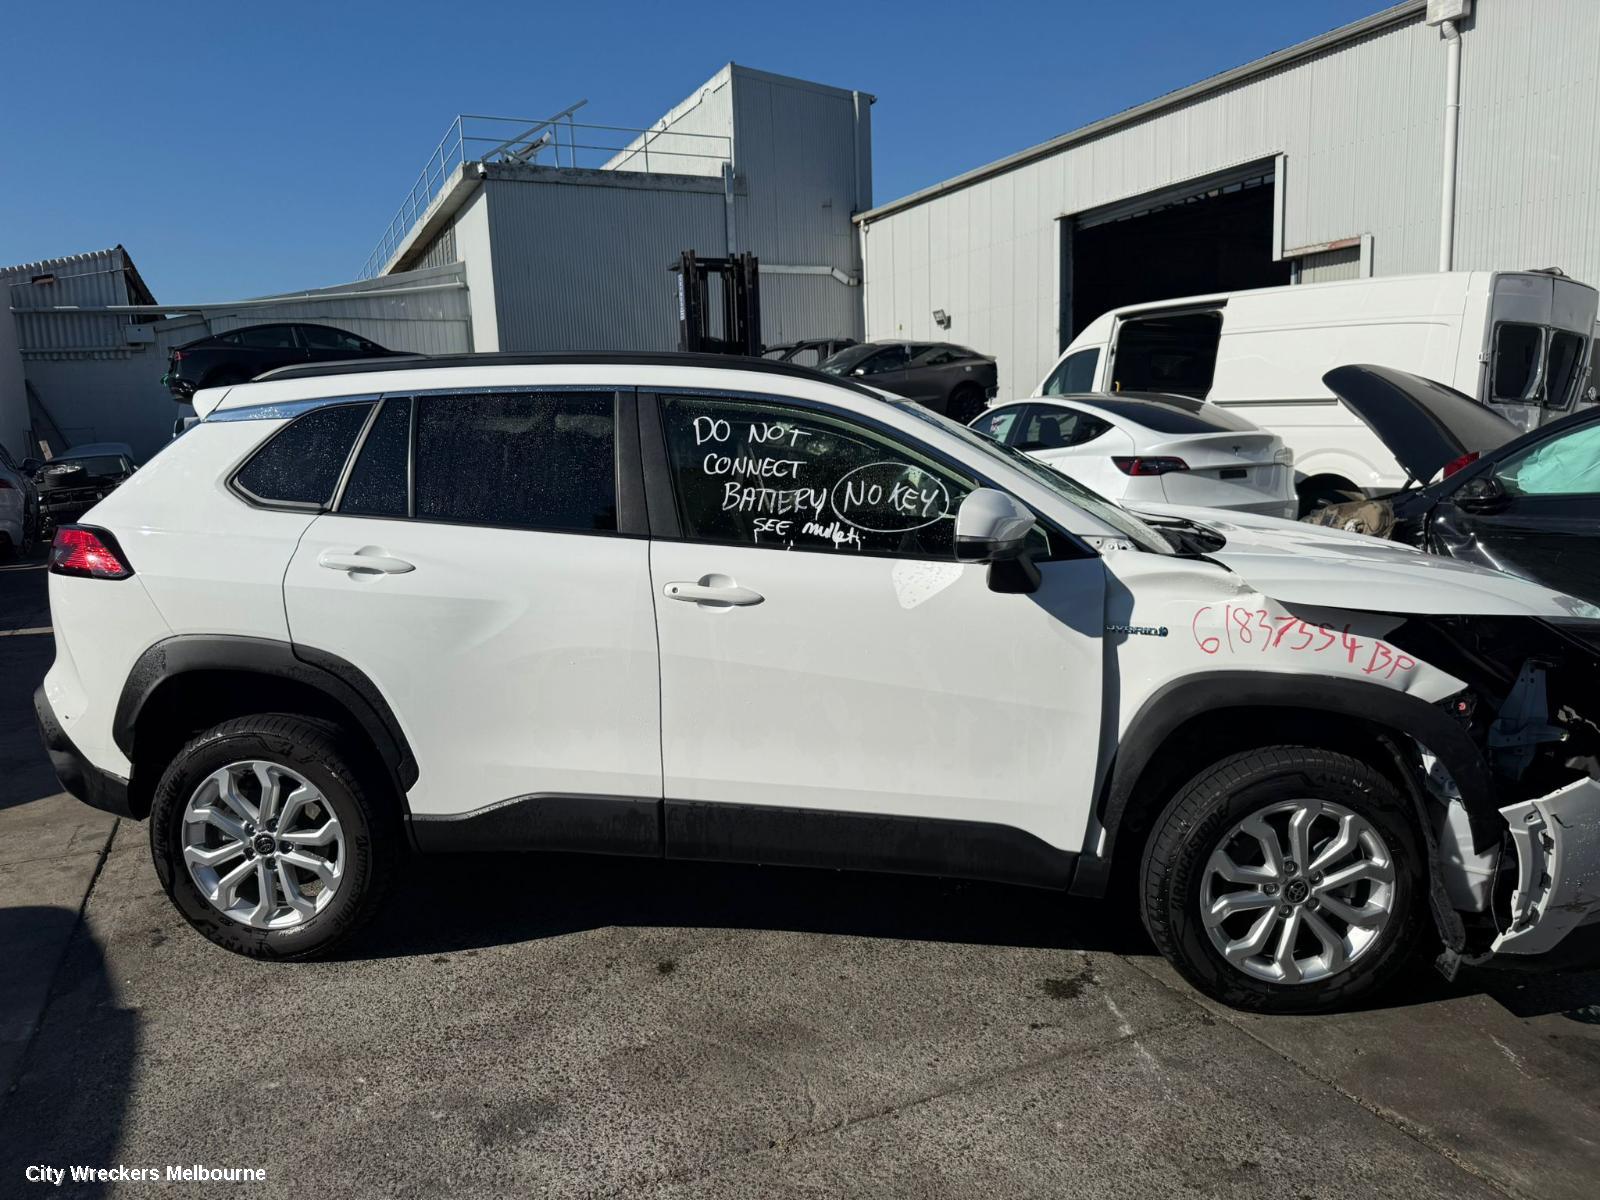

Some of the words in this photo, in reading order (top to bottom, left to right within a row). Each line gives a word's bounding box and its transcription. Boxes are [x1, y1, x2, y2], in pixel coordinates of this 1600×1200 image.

[693, 416, 731, 446] DO
[748, 423, 812, 447] NOT
[703, 453, 807, 479] CONNECT
[722, 482, 826, 518] BATTERY
[844, 480, 882, 512] NO
[887, 481, 938, 517] KEY
[753, 517, 793, 536] SEE
